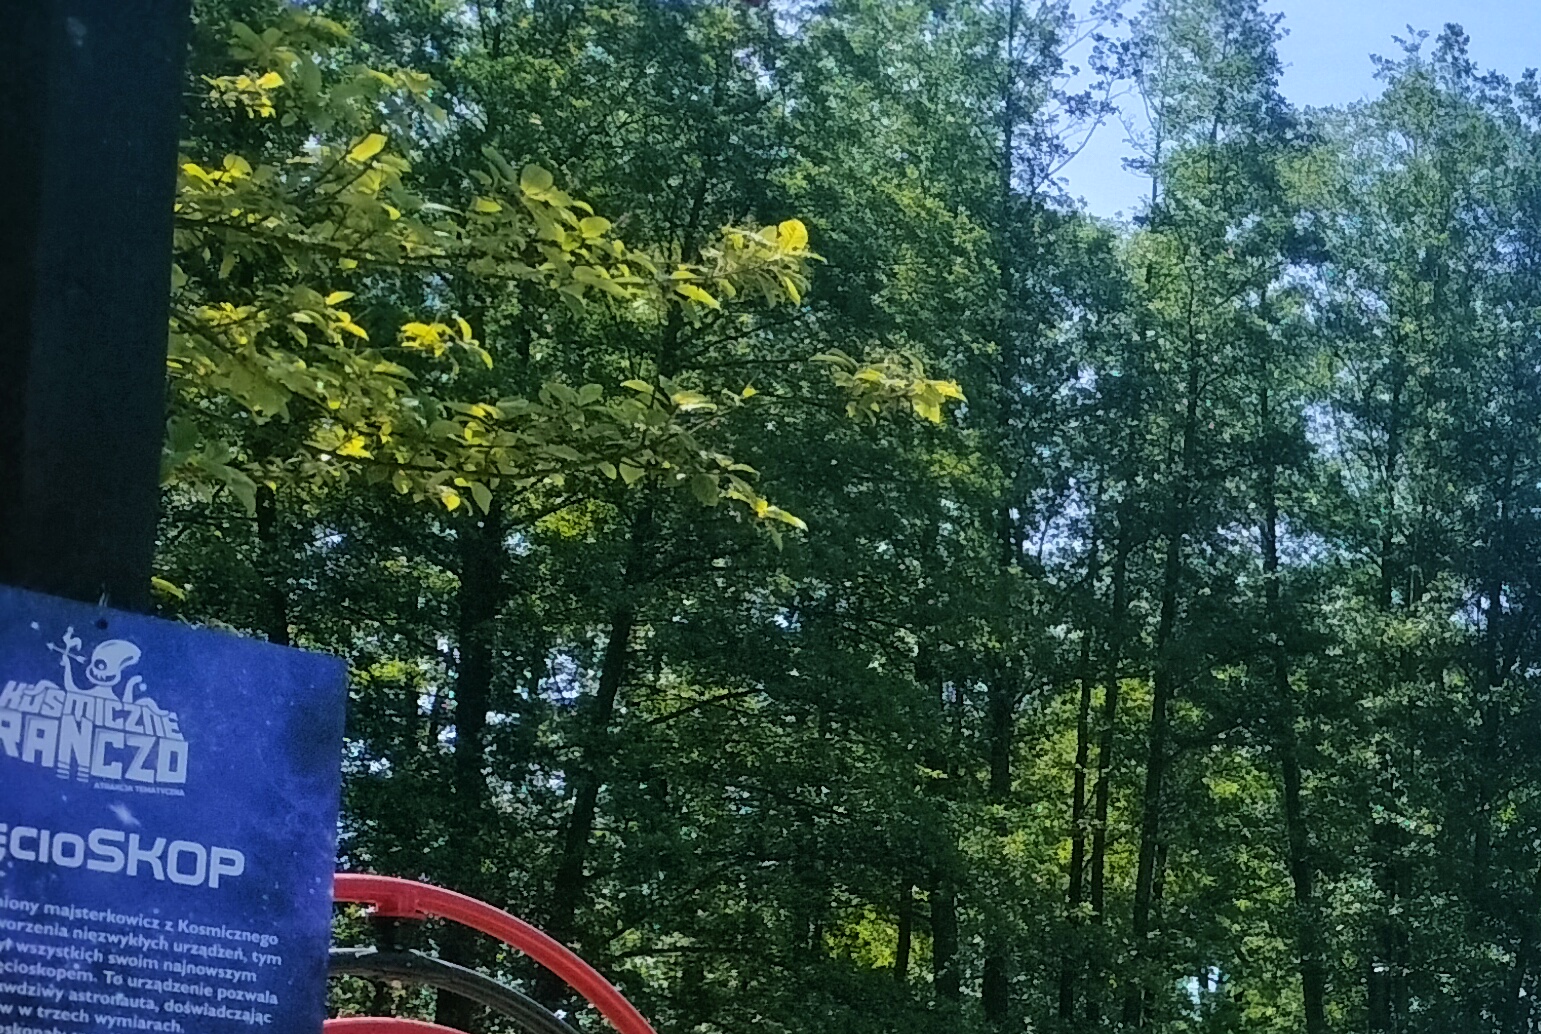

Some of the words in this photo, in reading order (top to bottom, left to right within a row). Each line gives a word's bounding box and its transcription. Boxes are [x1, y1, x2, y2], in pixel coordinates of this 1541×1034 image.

[0, 679, 185, 741] KOSMICZNE
[44, 903, 160, 930] majsterkowicz
[165, 922, 174, 932] z
[178, 919, 279, 947] Kosmicznego
[16, 942, 103, 963] wszystkich
[108, 952, 158, 970] swoim
[163, 959, 257, 982] najnowszym
[73, 926, 168, 951] niezwykłych
[173, 941, 248, 963] urządzeń,
[252, 951, 282, 967] tym
[103, 970, 123, 985] To
[127, 977, 213, 997] urządzenie
[217, 988, 278, 1004] pozwala
[18, 1005, 32, 1016] w
[37, 1005, 89, 1023] trzech
[94, 1012, 185, 1033] wymiarach.
[69, 991, 159, 1012] astronauta,
[164, 1000, 273, 1025] doświadczając
